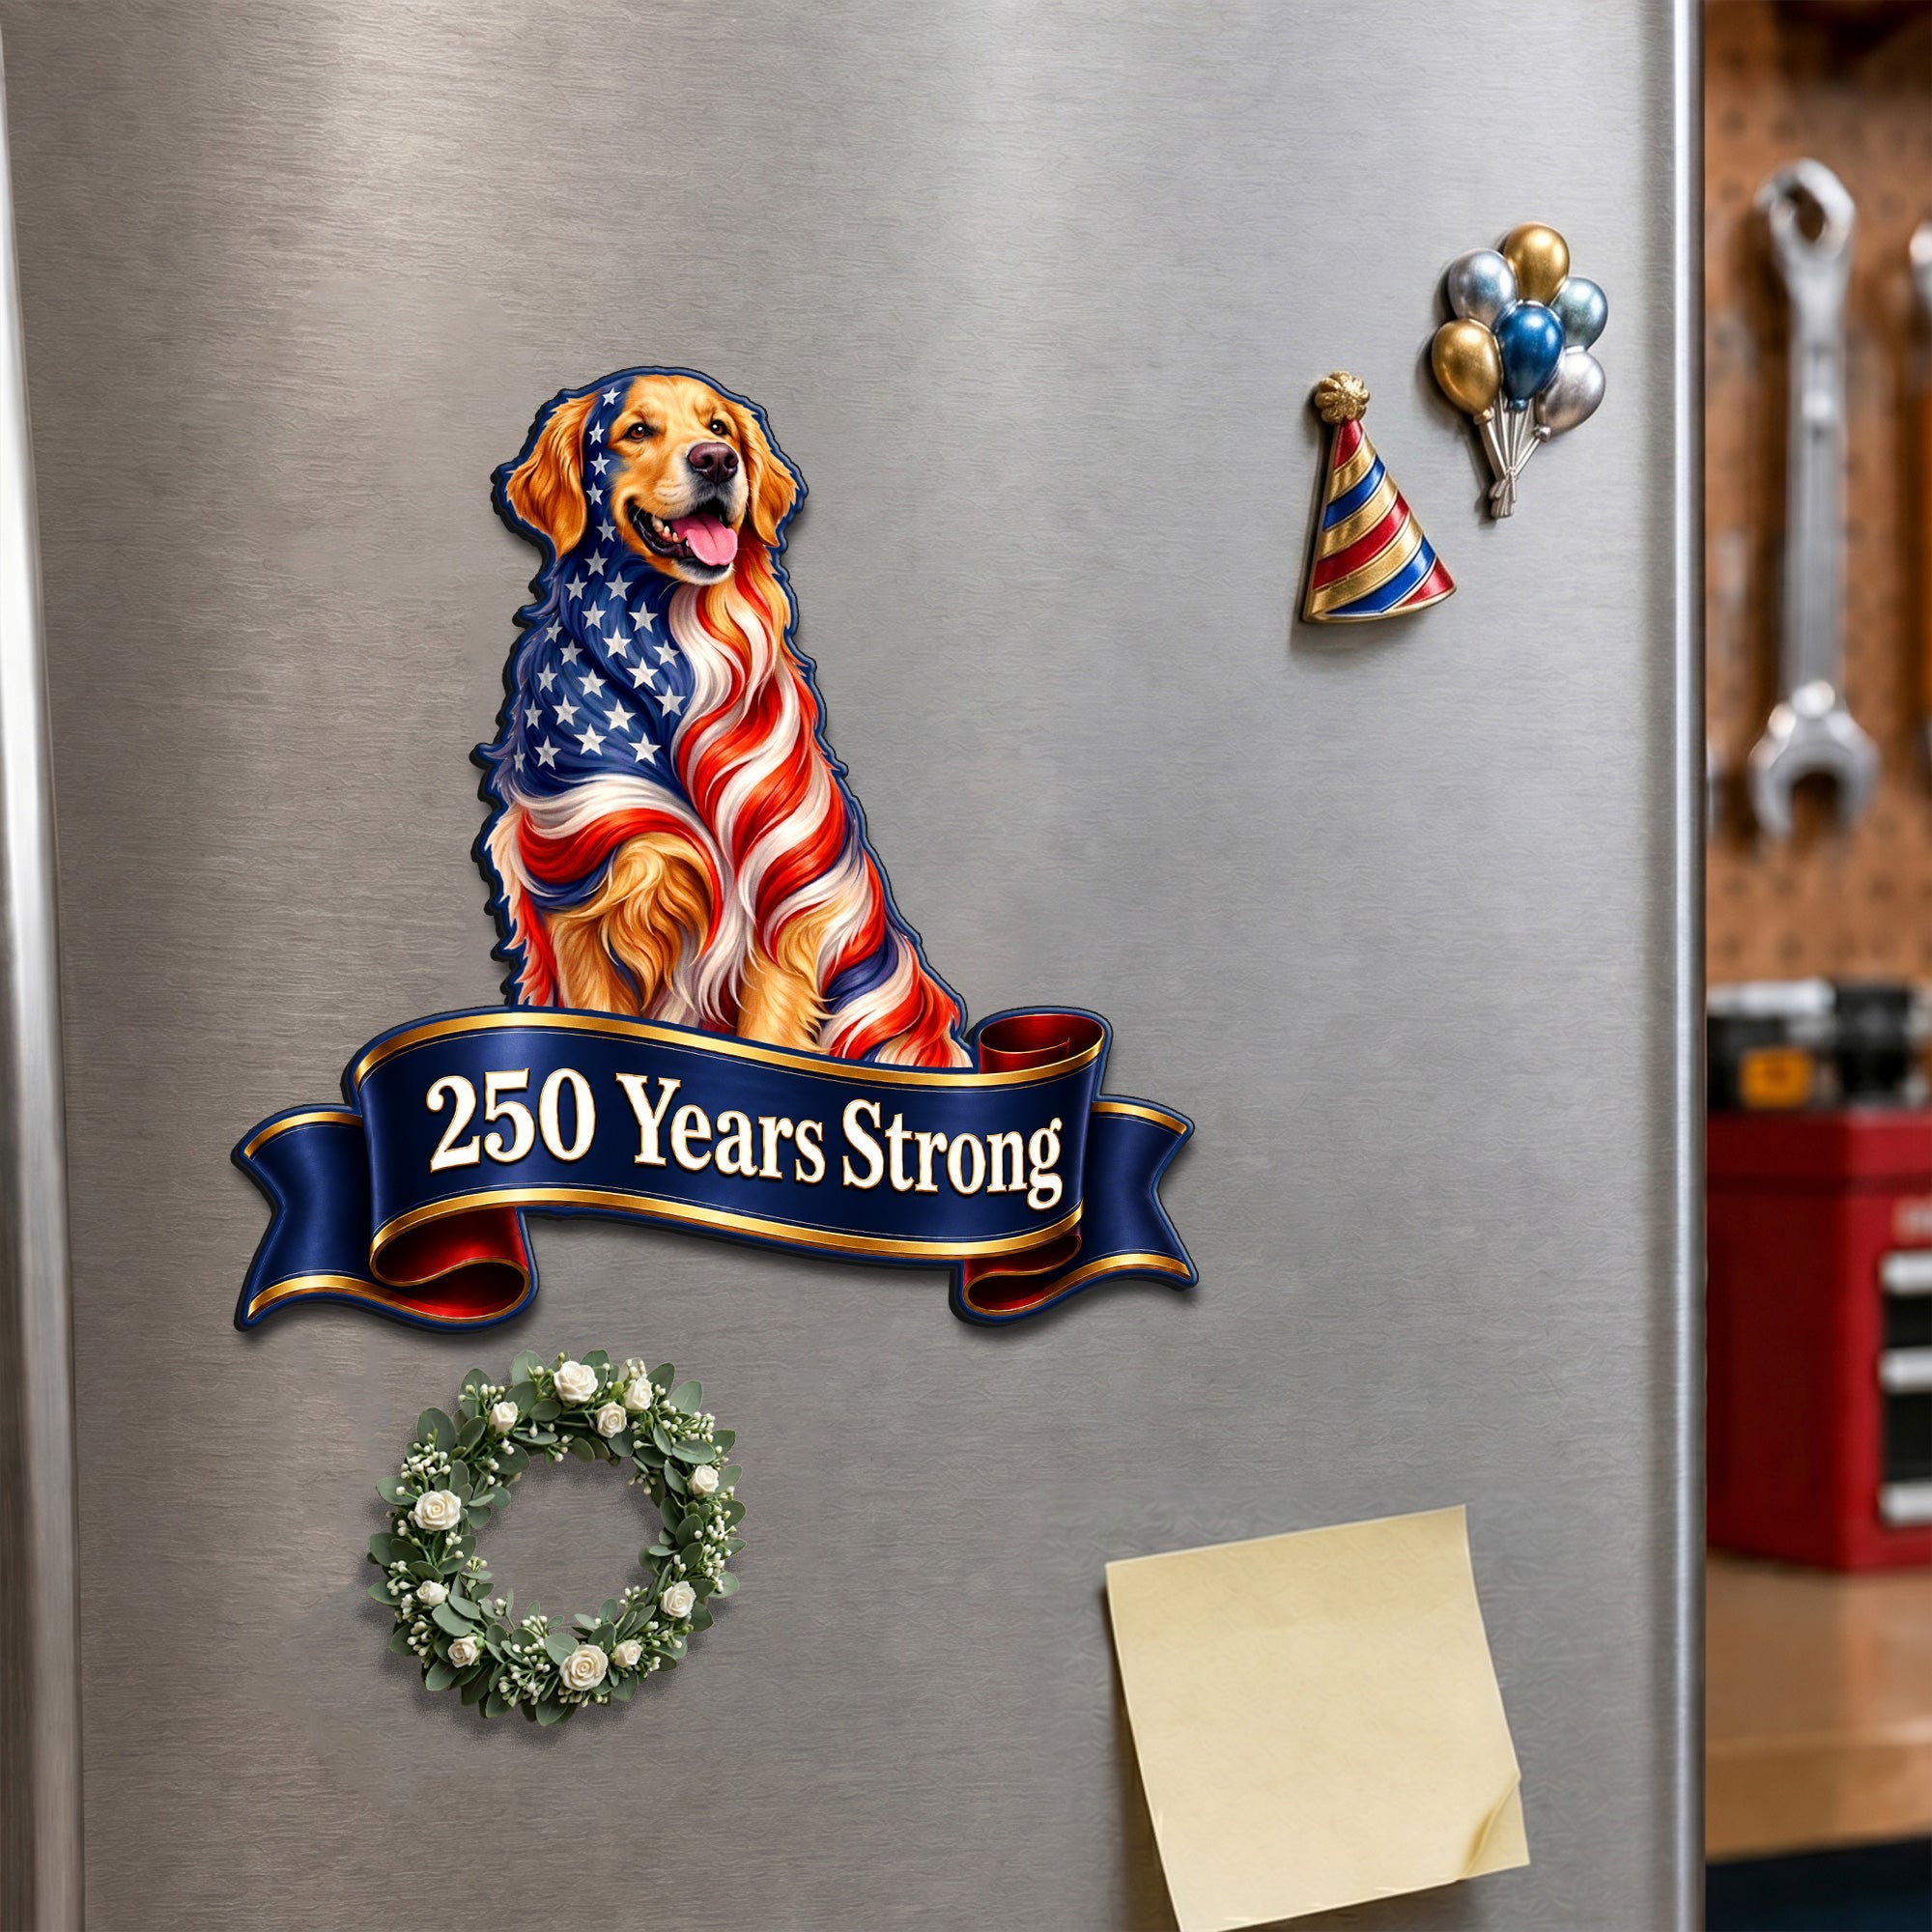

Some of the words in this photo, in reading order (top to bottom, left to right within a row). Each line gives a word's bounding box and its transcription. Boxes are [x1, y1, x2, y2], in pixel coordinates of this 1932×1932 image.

[426, 1067, 596, 1173] 250
[615, 1072, 826, 1183] Years
[841, 1098, 1064, 1211] Strong
